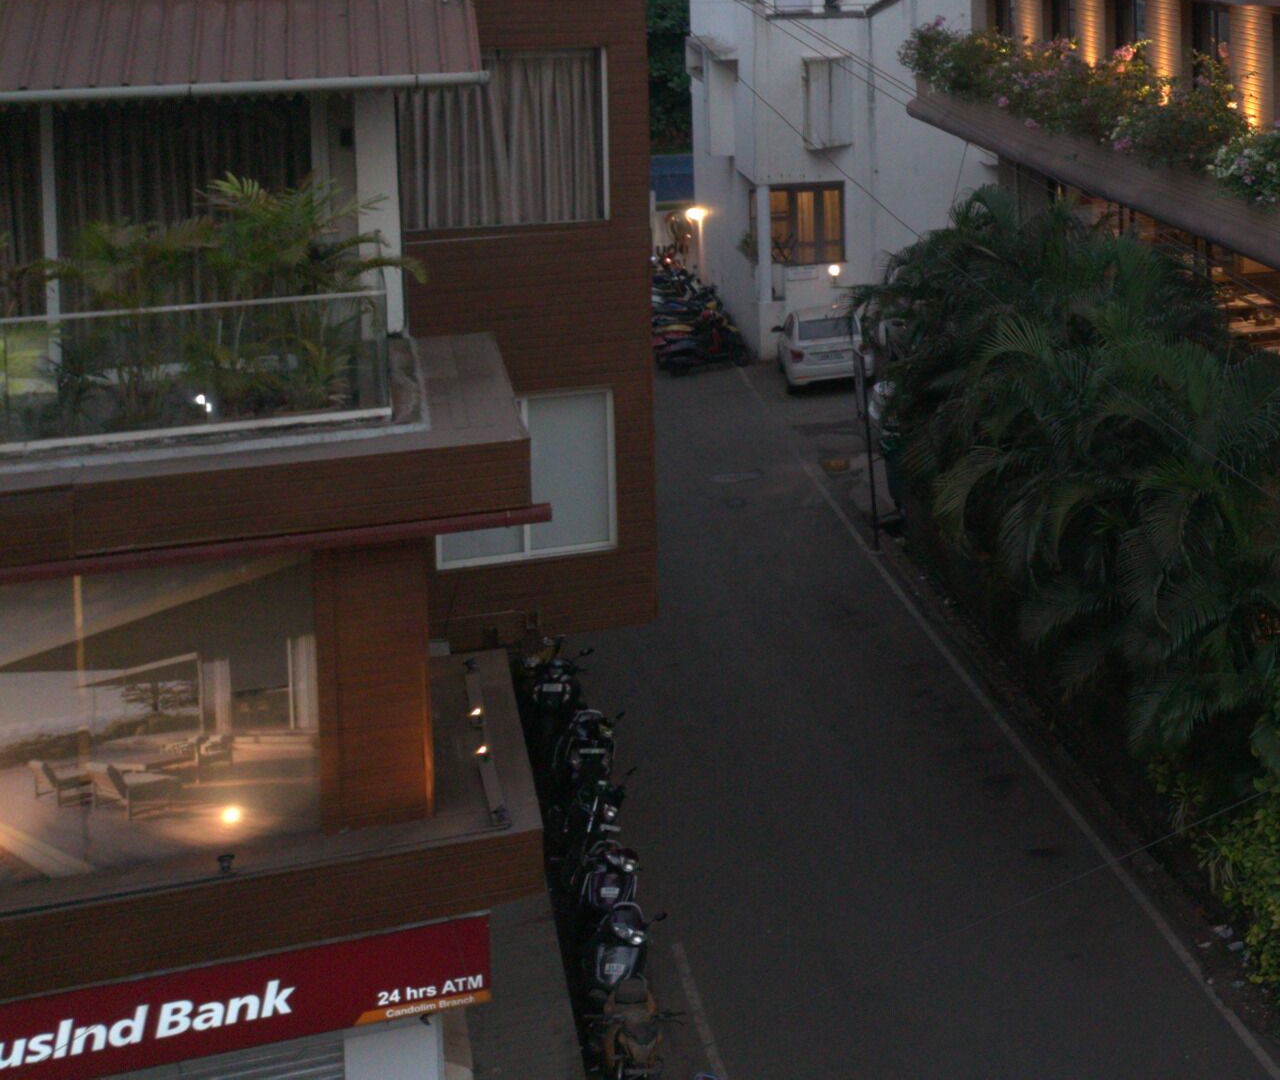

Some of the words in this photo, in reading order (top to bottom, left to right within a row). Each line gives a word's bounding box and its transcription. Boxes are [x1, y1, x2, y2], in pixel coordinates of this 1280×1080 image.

[377, 989, 401, 1006] 24
[406, 985, 437, 1000] hrs
[441, 974, 483, 994] ATM
[155, 979, 295, 1039] Bank
[385, 1003, 436, 1018] Candolim
[438, 995, 475, 1008] Branch
